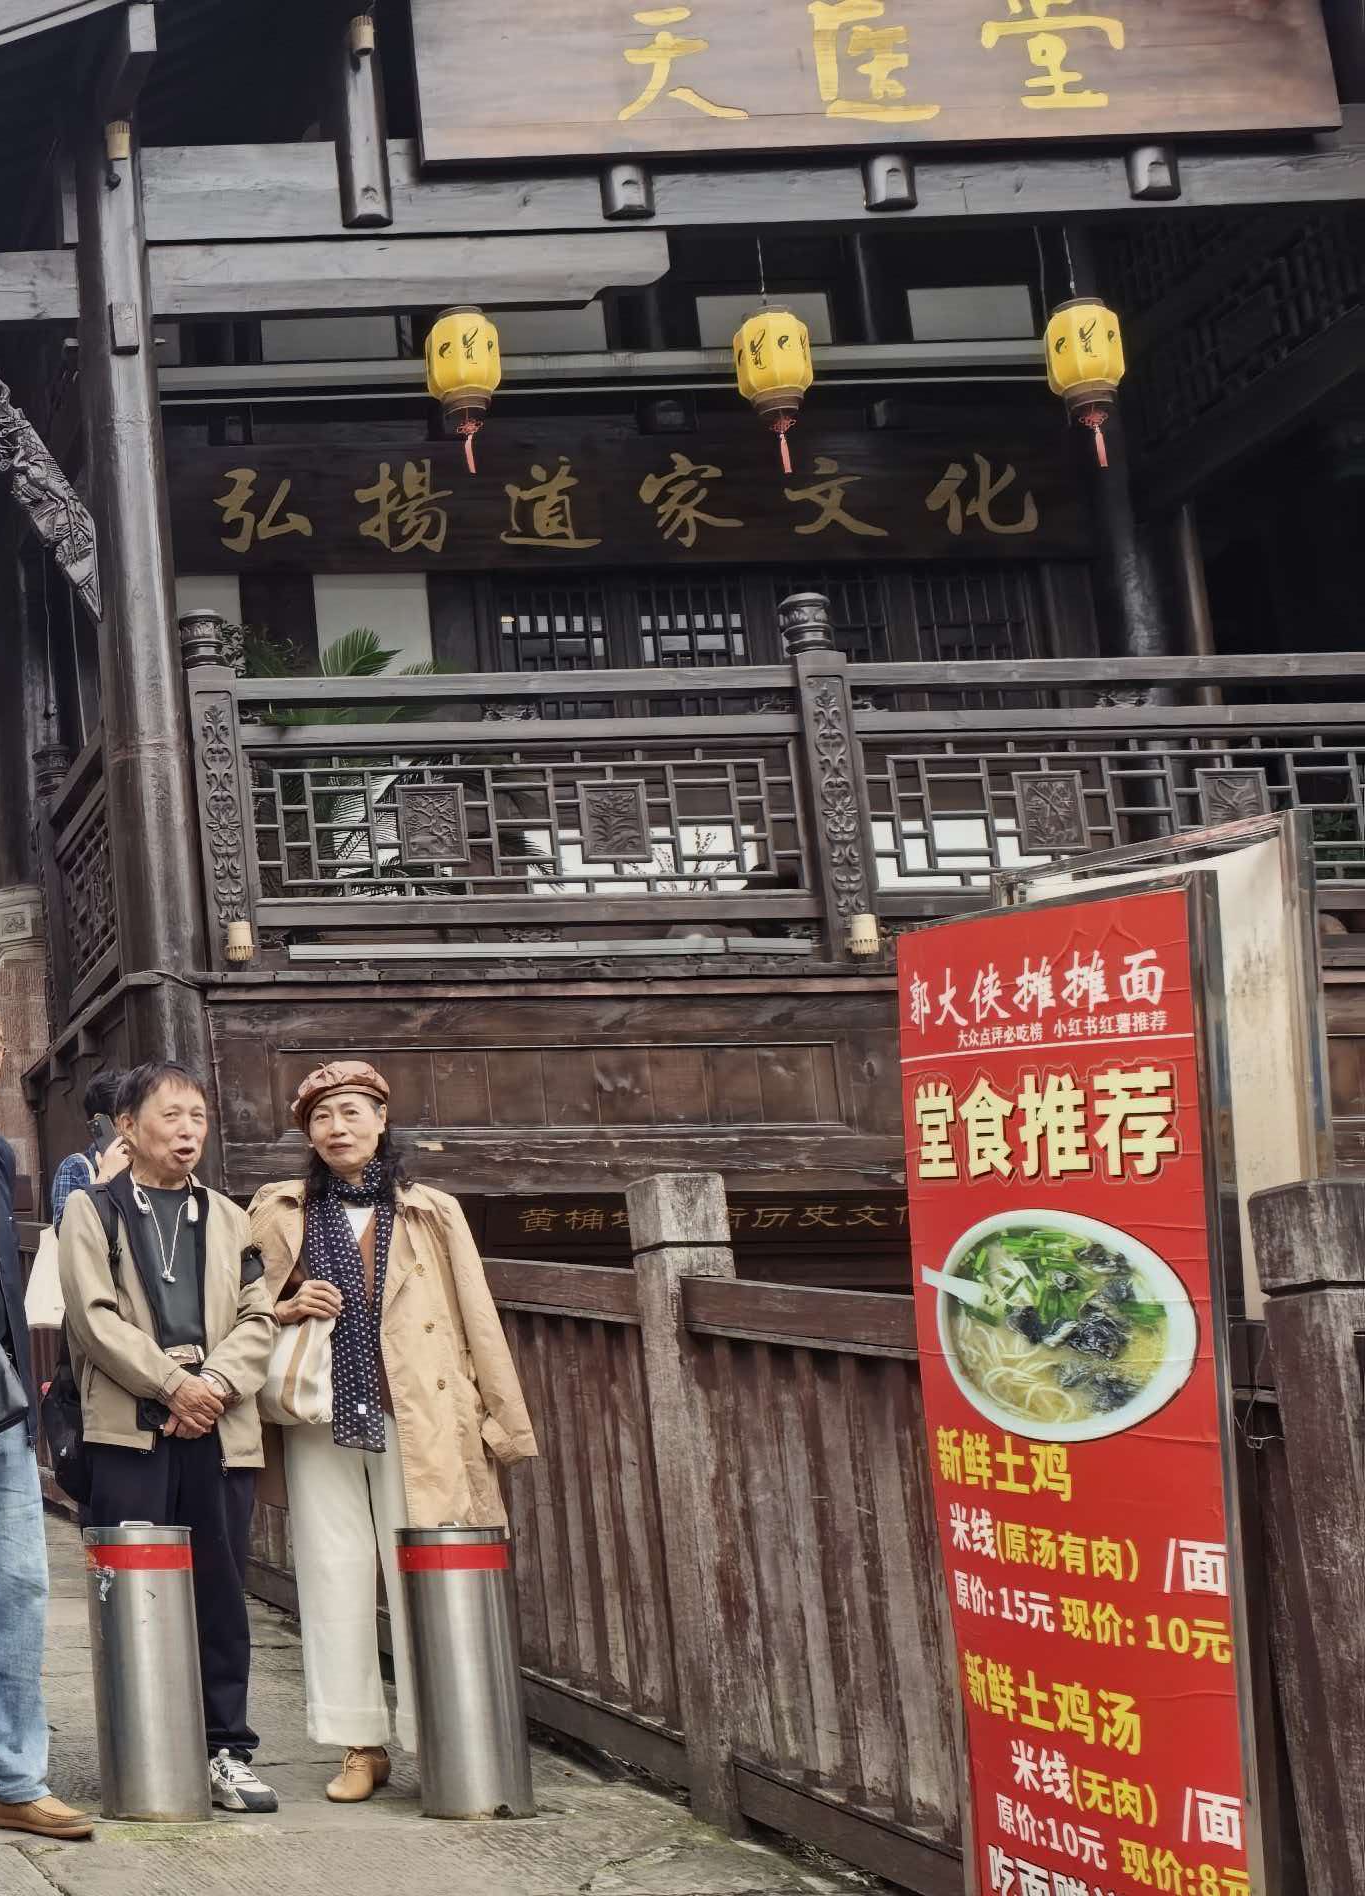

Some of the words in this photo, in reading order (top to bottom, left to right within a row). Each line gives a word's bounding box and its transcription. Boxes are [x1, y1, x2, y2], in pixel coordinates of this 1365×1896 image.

[213, 452, 1037, 552] 弘揚道家文化
[910, 949, 1166, 1036] 郭大侠摊摊面
[957, 1023, 1044, 1050] 大众点评必吃榜
[1053, 1010, 1169, 1038] 小红书红薯推荐
[914, 1066, 1177, 1180] 堂食推荐
[936, 1425, 1072, 1502] 新鲜土鸡
[964, 1649, 1142, 1755] 新鲜土鸡汤
[988, 1844, 1118, 1896] 吃面赠
